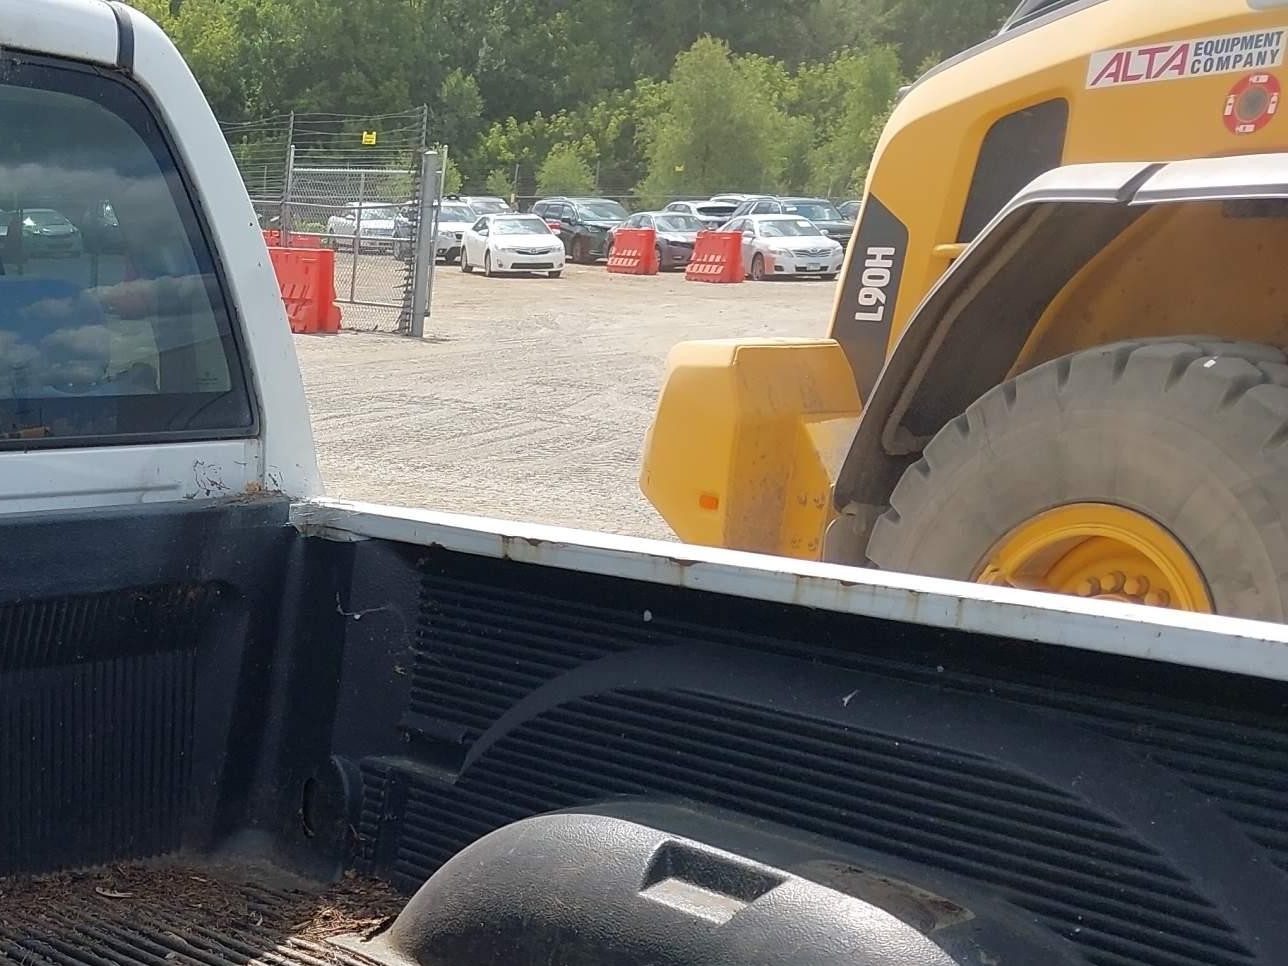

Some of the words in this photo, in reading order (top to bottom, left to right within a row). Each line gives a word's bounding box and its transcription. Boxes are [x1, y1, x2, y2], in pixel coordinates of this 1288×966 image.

[1193, 31, 1284, 57] EQUIPMENT
[1090, 43, 1190, 86] ALTA
[1190, 49, 1280, 74] COMPANY
[855, 247, 895, 321] L90H
